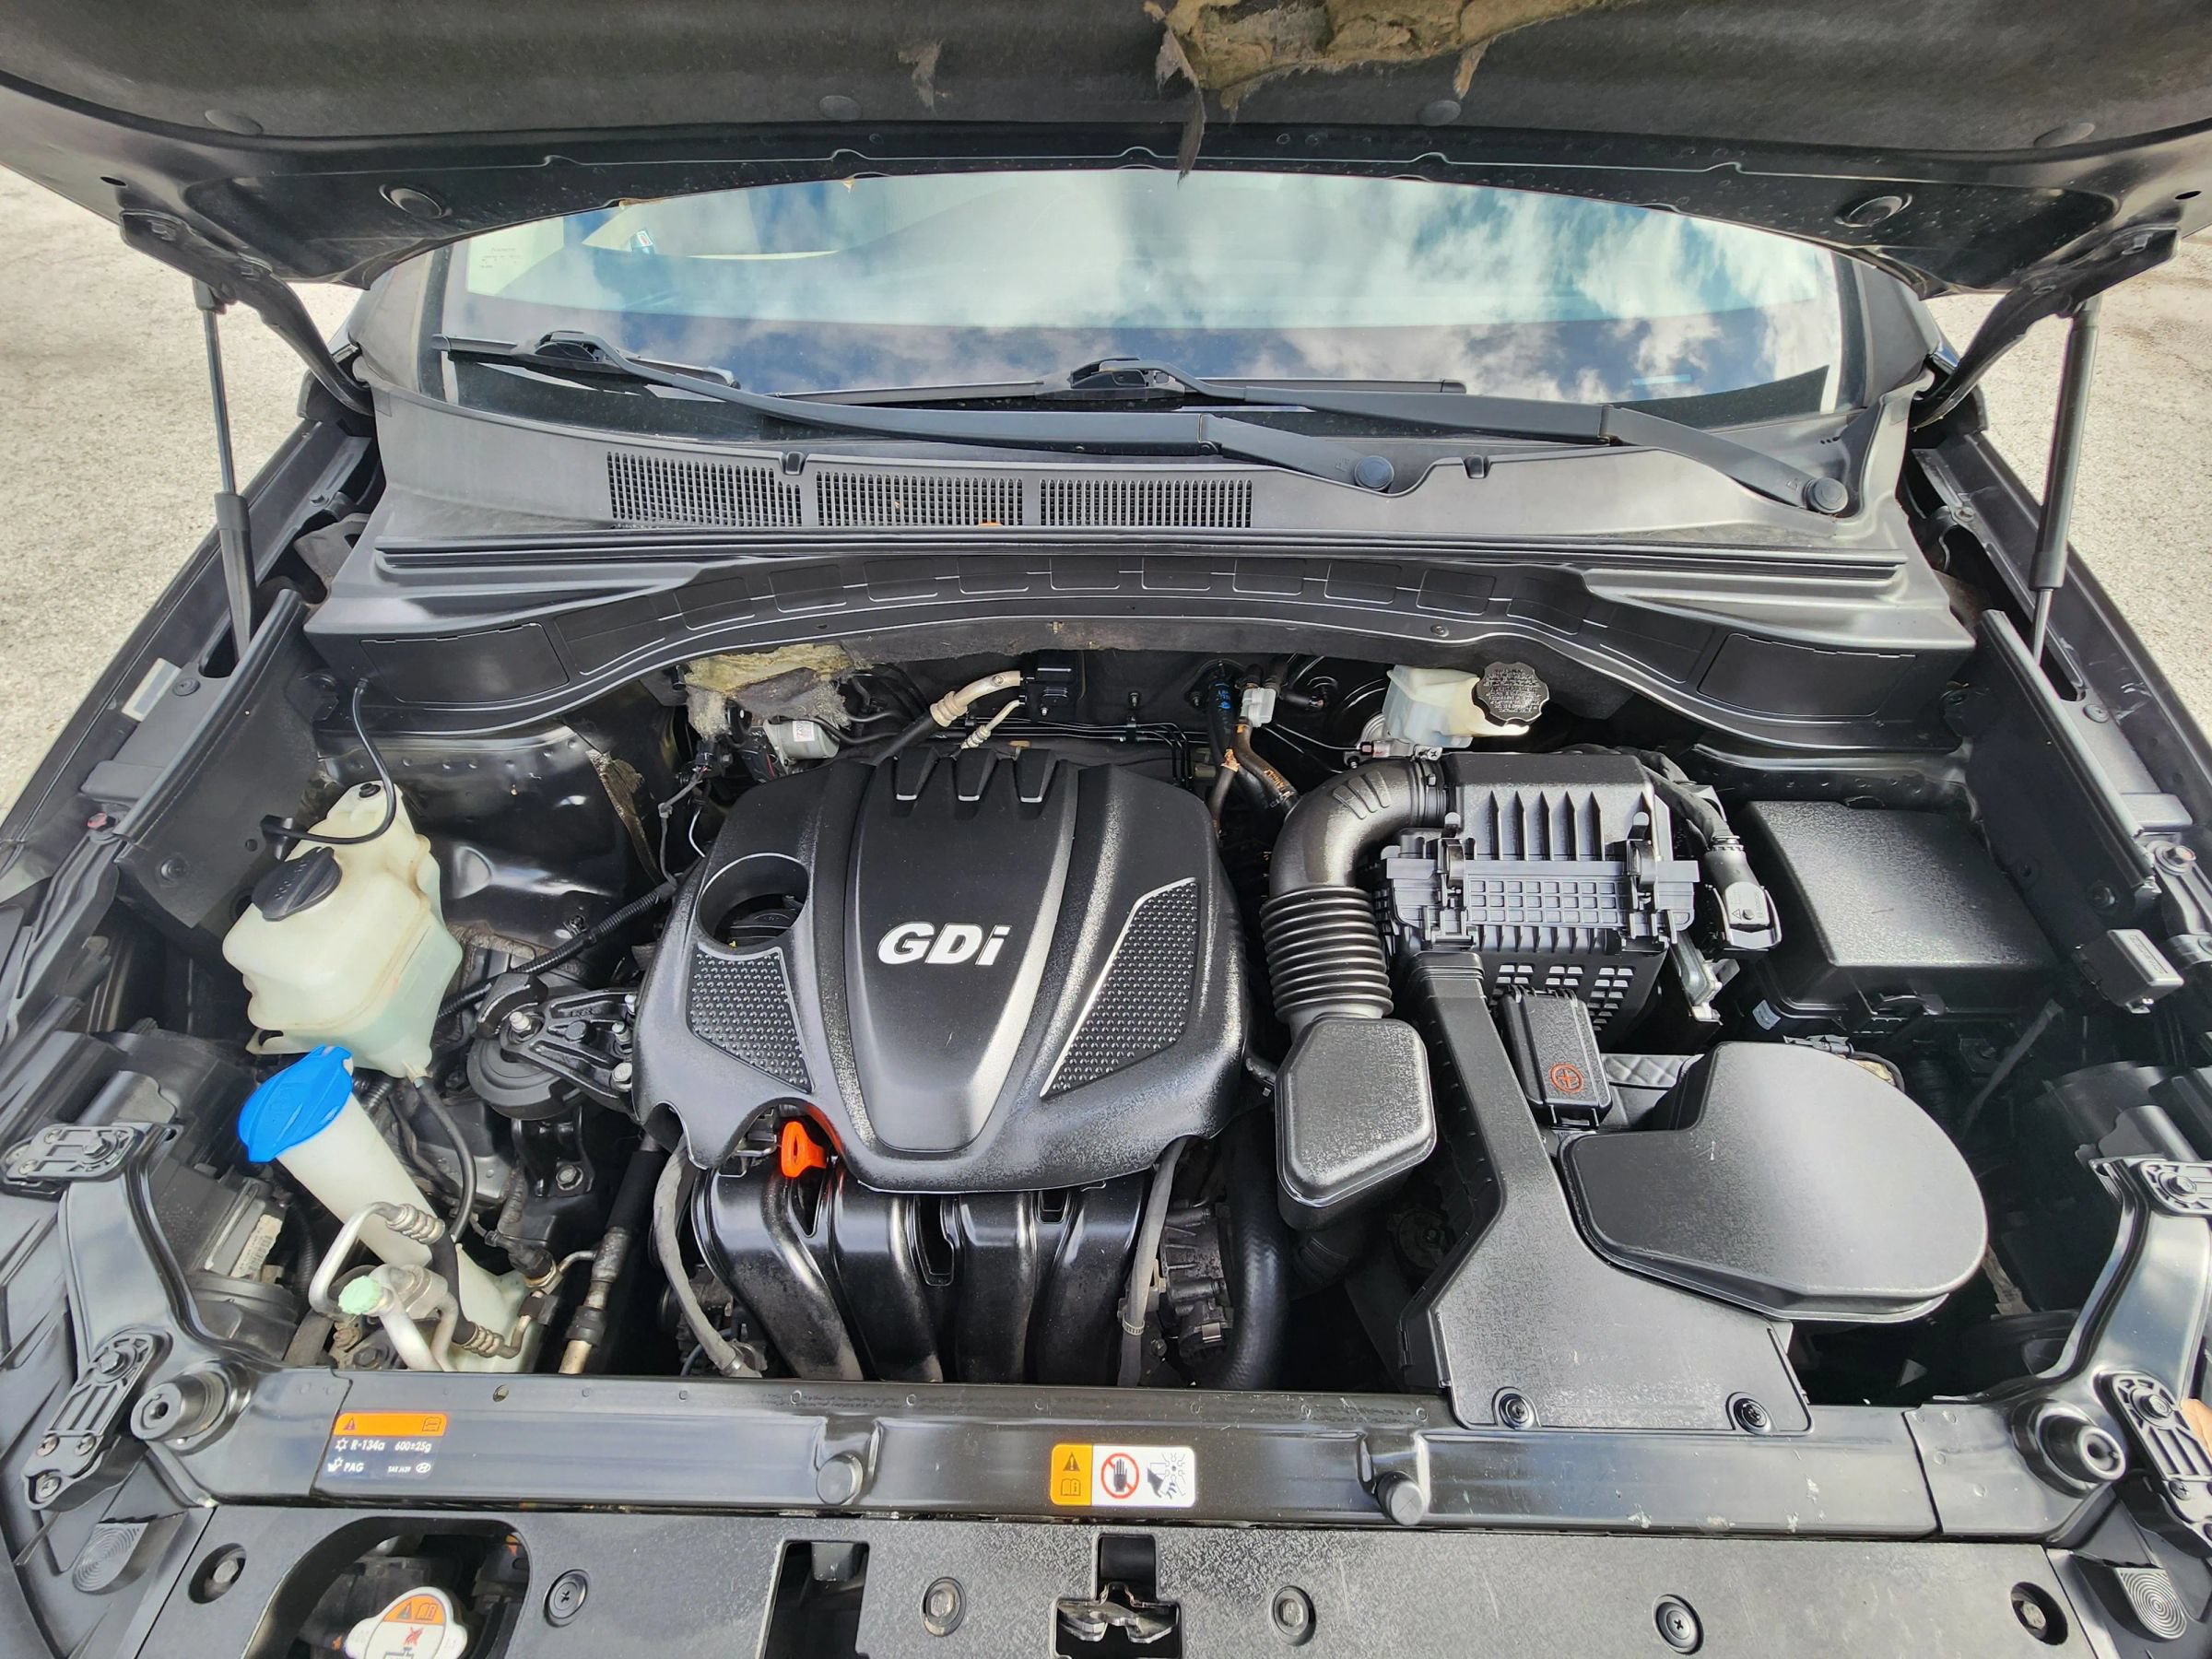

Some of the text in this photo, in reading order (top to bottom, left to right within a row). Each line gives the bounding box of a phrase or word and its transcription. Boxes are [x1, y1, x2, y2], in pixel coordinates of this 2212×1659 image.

[877, 921, 1013, 966] GDi
[350, 1439, 385, 1452] R-134a
[343, 1462, 365, 1473] PAG
